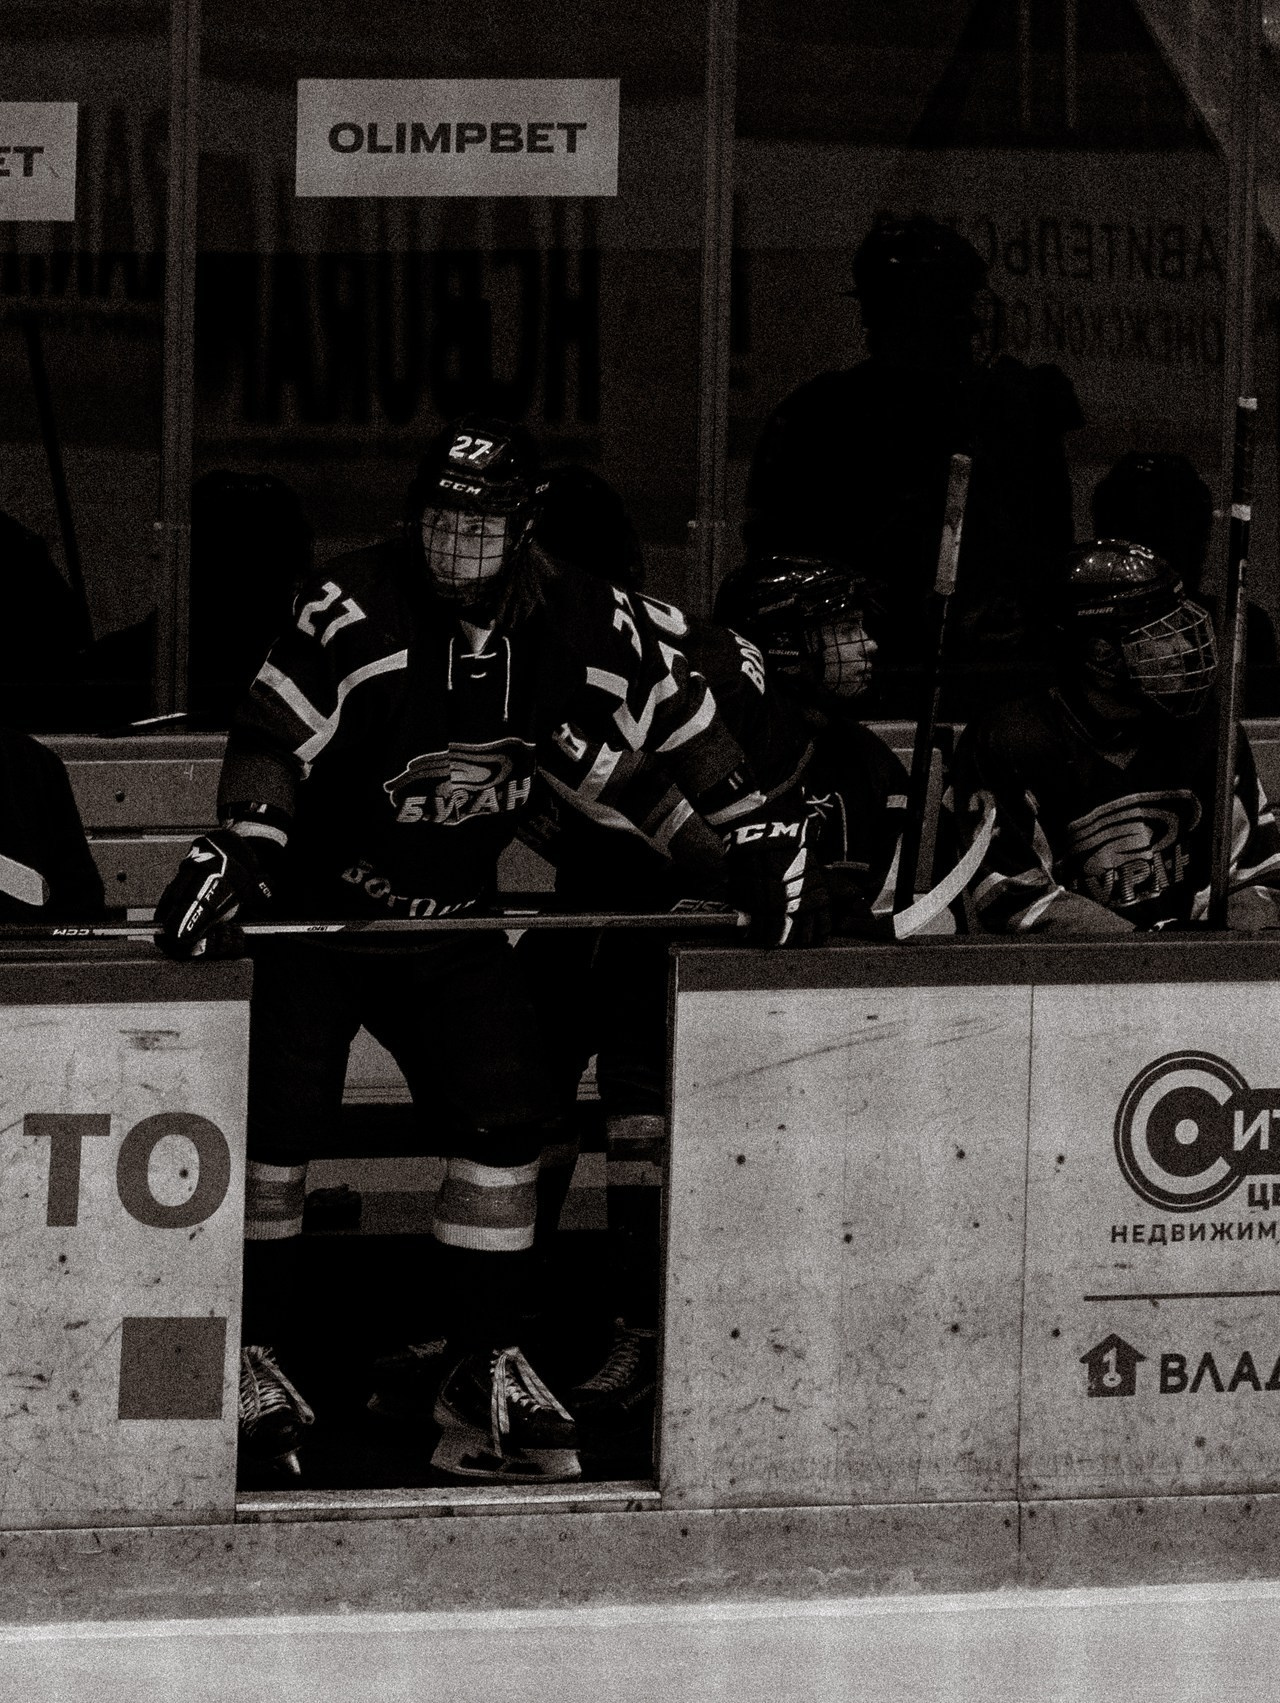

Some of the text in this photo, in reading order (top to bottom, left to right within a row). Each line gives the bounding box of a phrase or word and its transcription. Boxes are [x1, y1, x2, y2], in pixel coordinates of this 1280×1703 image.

[327, 121, 588, 154] OLIMPBET
[448, 434, 494, 460] 27
[439, 478, 482, 495] CCM
[296, 581, 367, 649] 27
[396, 776, 532, 824] БУРАН
[23, 1111, 232, 1229] ТО
